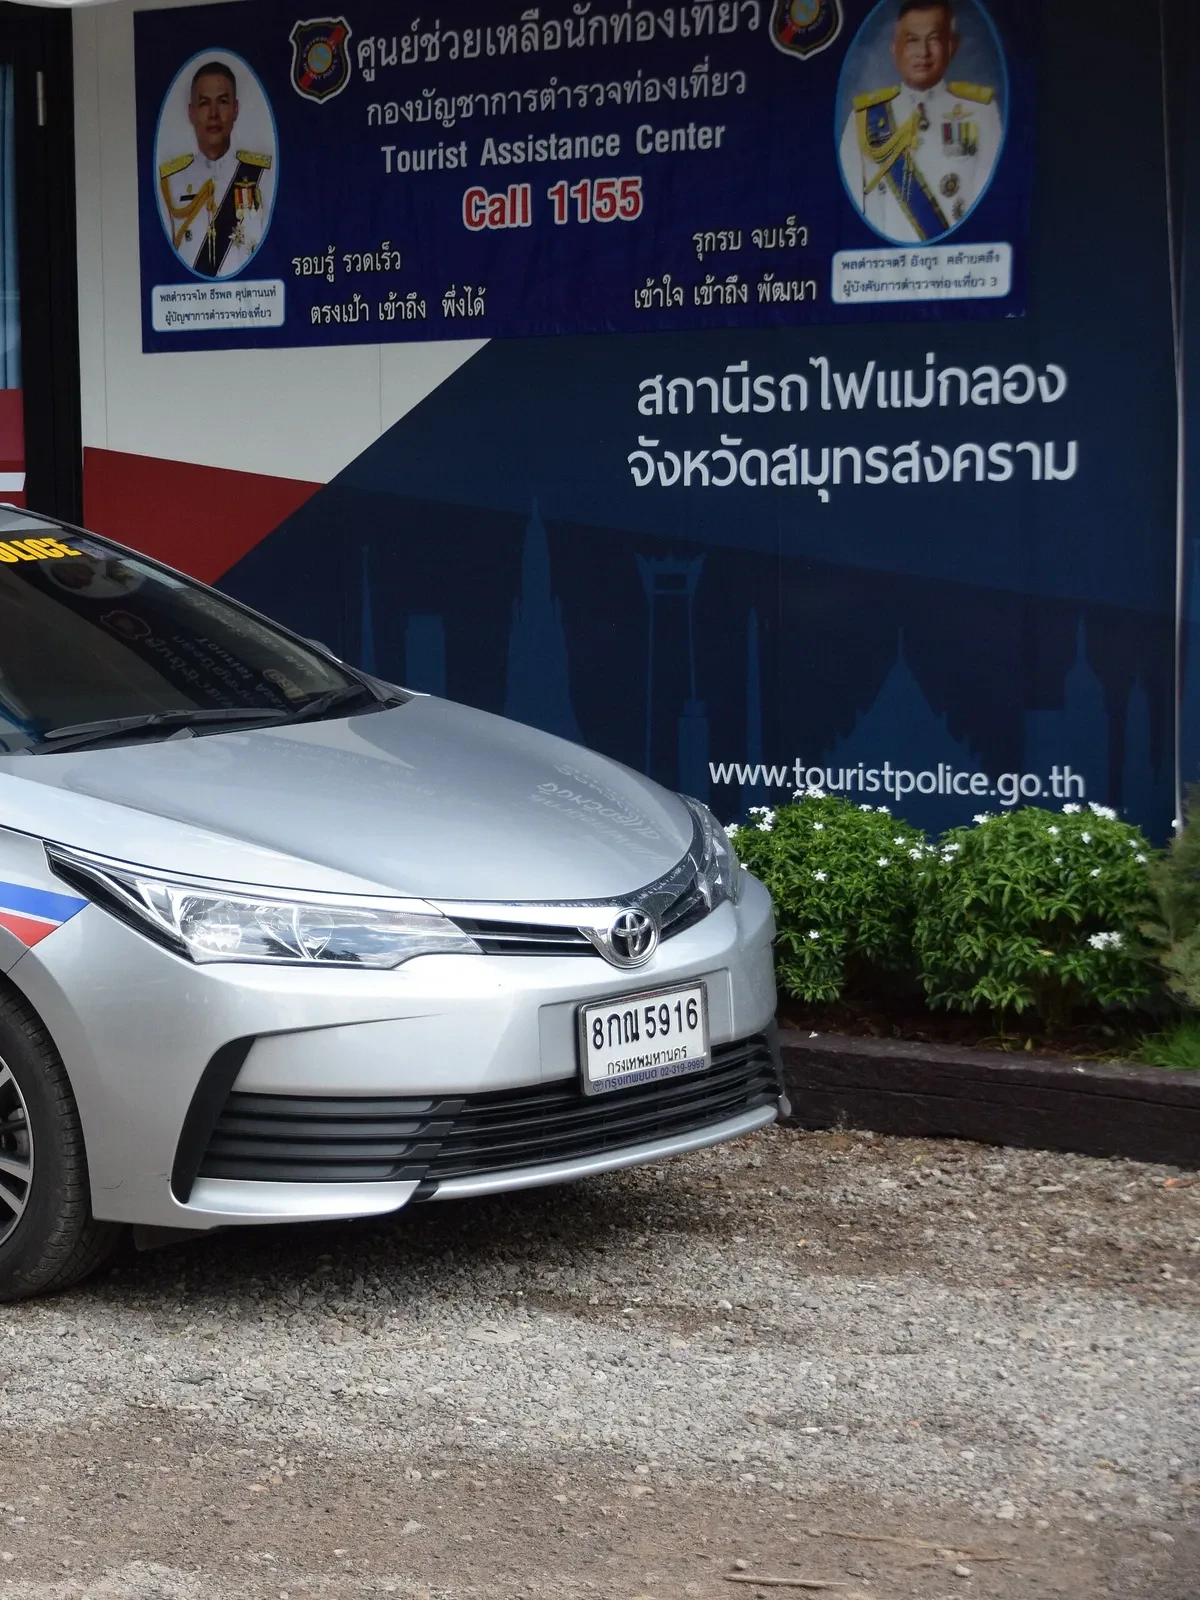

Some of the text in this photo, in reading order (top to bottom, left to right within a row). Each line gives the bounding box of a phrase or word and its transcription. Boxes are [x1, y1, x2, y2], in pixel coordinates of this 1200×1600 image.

[357, 0, 760, 82] ศูนย์ช่วยเหลือนักท่องเทยว
[366, 57, 747, 128] กองบัญชาการตำรวจท่องเที่ยว
[380, 122, 727, 174] Tourist Assistance Center
[462, 176, 644, 231] Call 1155
[291, 241, 402, 283] รอบรู้ รวดเร็ว
[692, 215, 809, 262] รุกรบ จบเร็ว
[310, 284, 486, 324] ตรงเป้า เข้าถึง พึ่งได้
[634, 272, 818, 309] เข้าใจ เข้าถึง พัฒนา
[990, 276, 998, 287] 3
[637, 352, 1068, 416] สถานีรถไฟแม่กลอง
[627, 434, 1077, 503] จังหวัดสมุทรสงคราม
[708, 757, 1085, 806] www.touristpolice.go.th
[644, 997, 698, 1039] 5916
[660, 1059, 705, 1077] 02-319-9999
